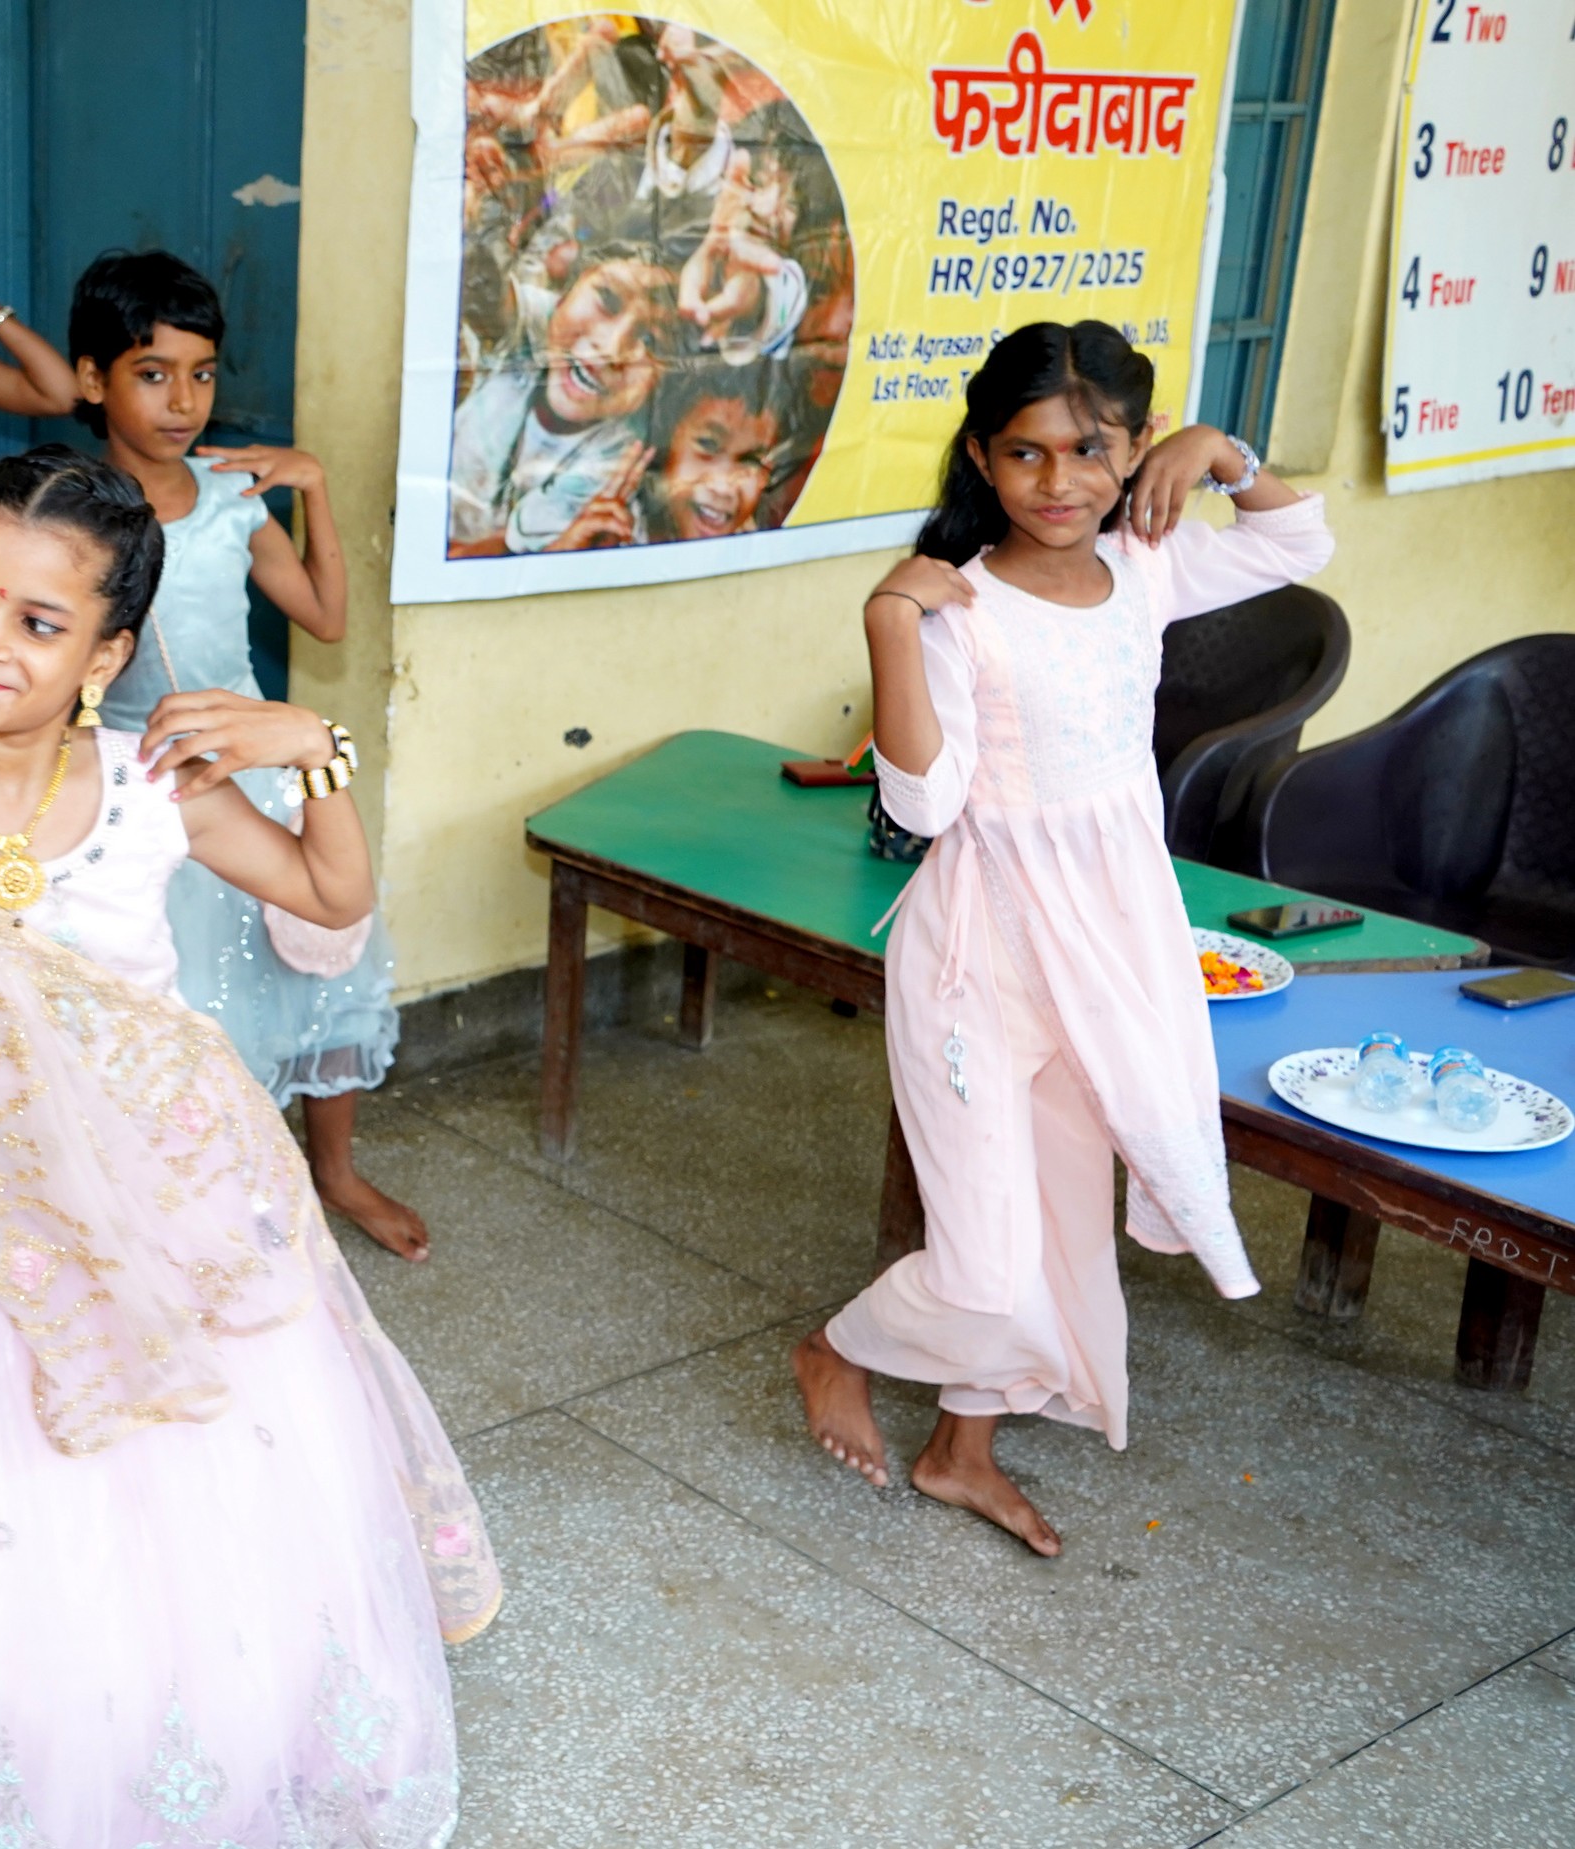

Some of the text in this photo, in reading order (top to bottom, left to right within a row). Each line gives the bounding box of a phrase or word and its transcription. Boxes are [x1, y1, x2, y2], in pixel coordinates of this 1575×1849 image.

[1432, 0, 1507, 42] 2 Two
[930, 32, 1195, 155] फरीदाबाद
[1414, 122, 1505, 179] 3 Three
[1548, 117, 1568, 172] 8
[937, 199, 1076, 244] Regd. No.
[929, 250, 1145, 297] HR/8927/2025
[1402, 256, 1476, 310] 4 Four
[1529, 244, 1549, 298] 9
[867, 333, 906, 361] Add:
[912, 333, 984, 364] Agrasan
[905, 371, 952, 400] Floor,
[1393, 385, 1460, 439] 5 Five
[1497, 369, 1575, 423] 10 Ten
